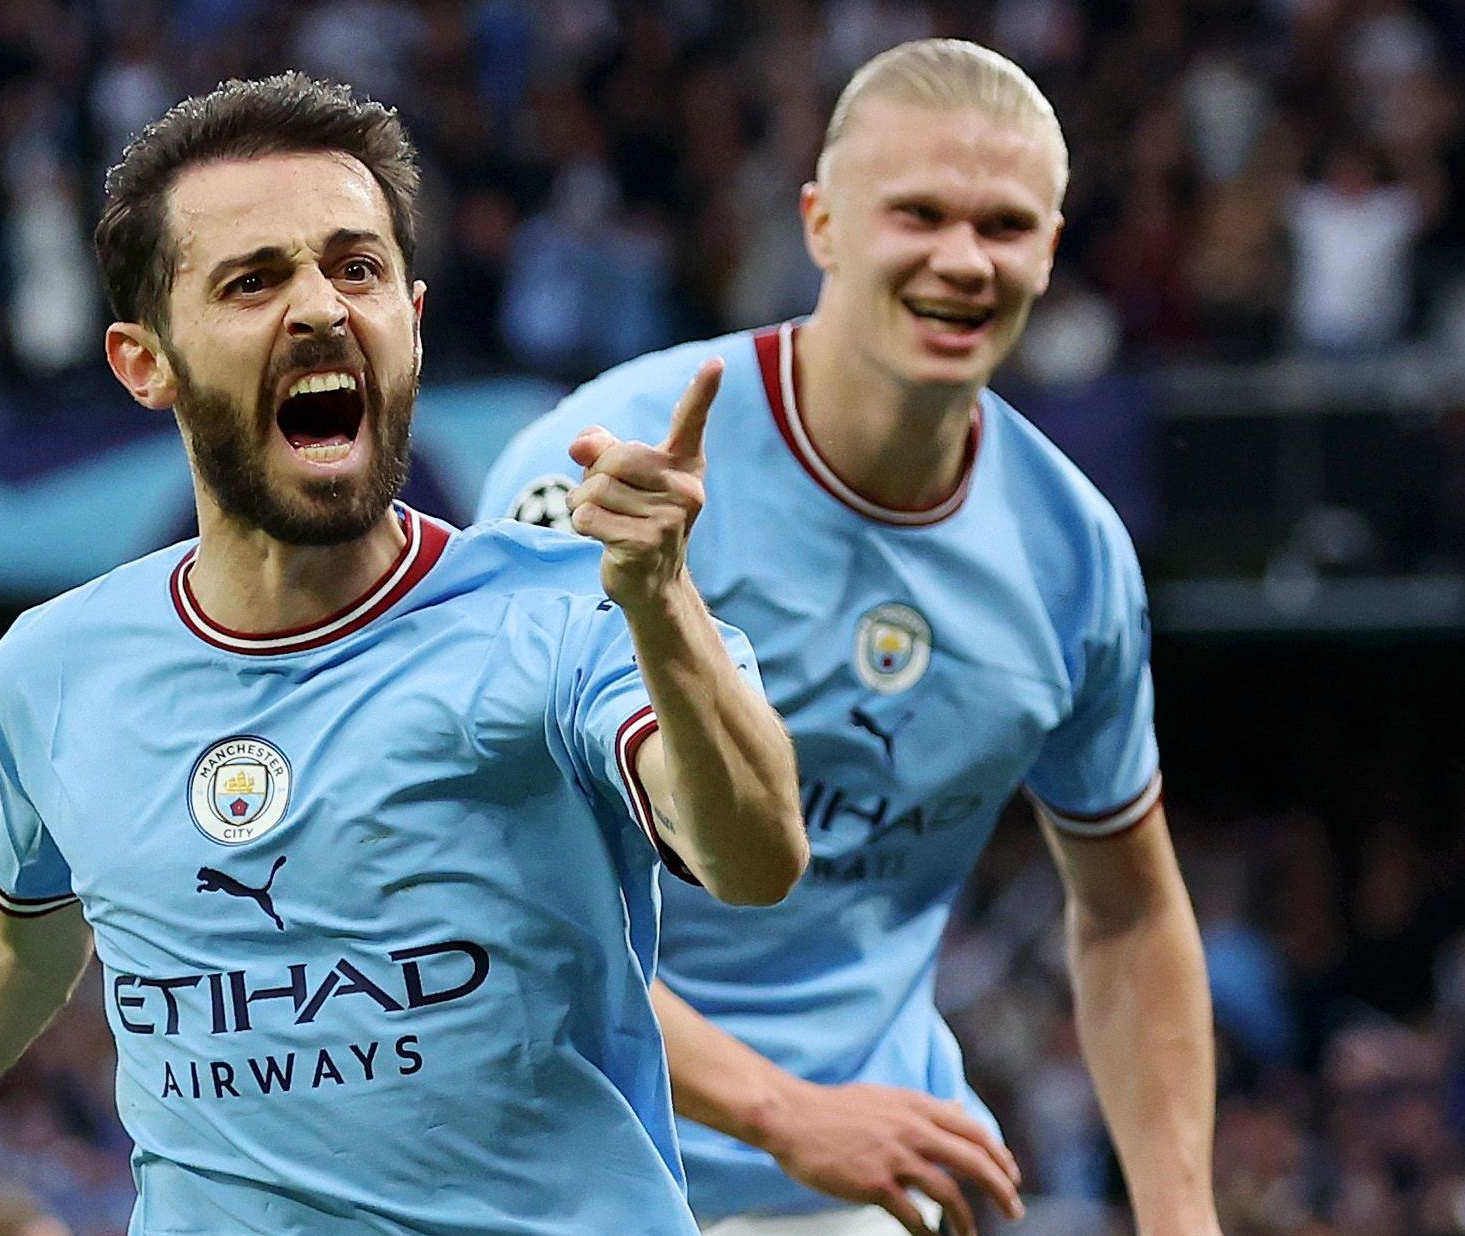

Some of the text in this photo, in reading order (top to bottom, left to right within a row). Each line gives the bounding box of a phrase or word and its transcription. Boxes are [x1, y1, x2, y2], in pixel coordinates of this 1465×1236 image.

[200, 744, 284, 778] MANCHESTER
[223, 828, 254, 839] CITY
[114, 940, 490, 1036] ETIHAD
[161, 1035, 423, 1099] AIRWAYS
